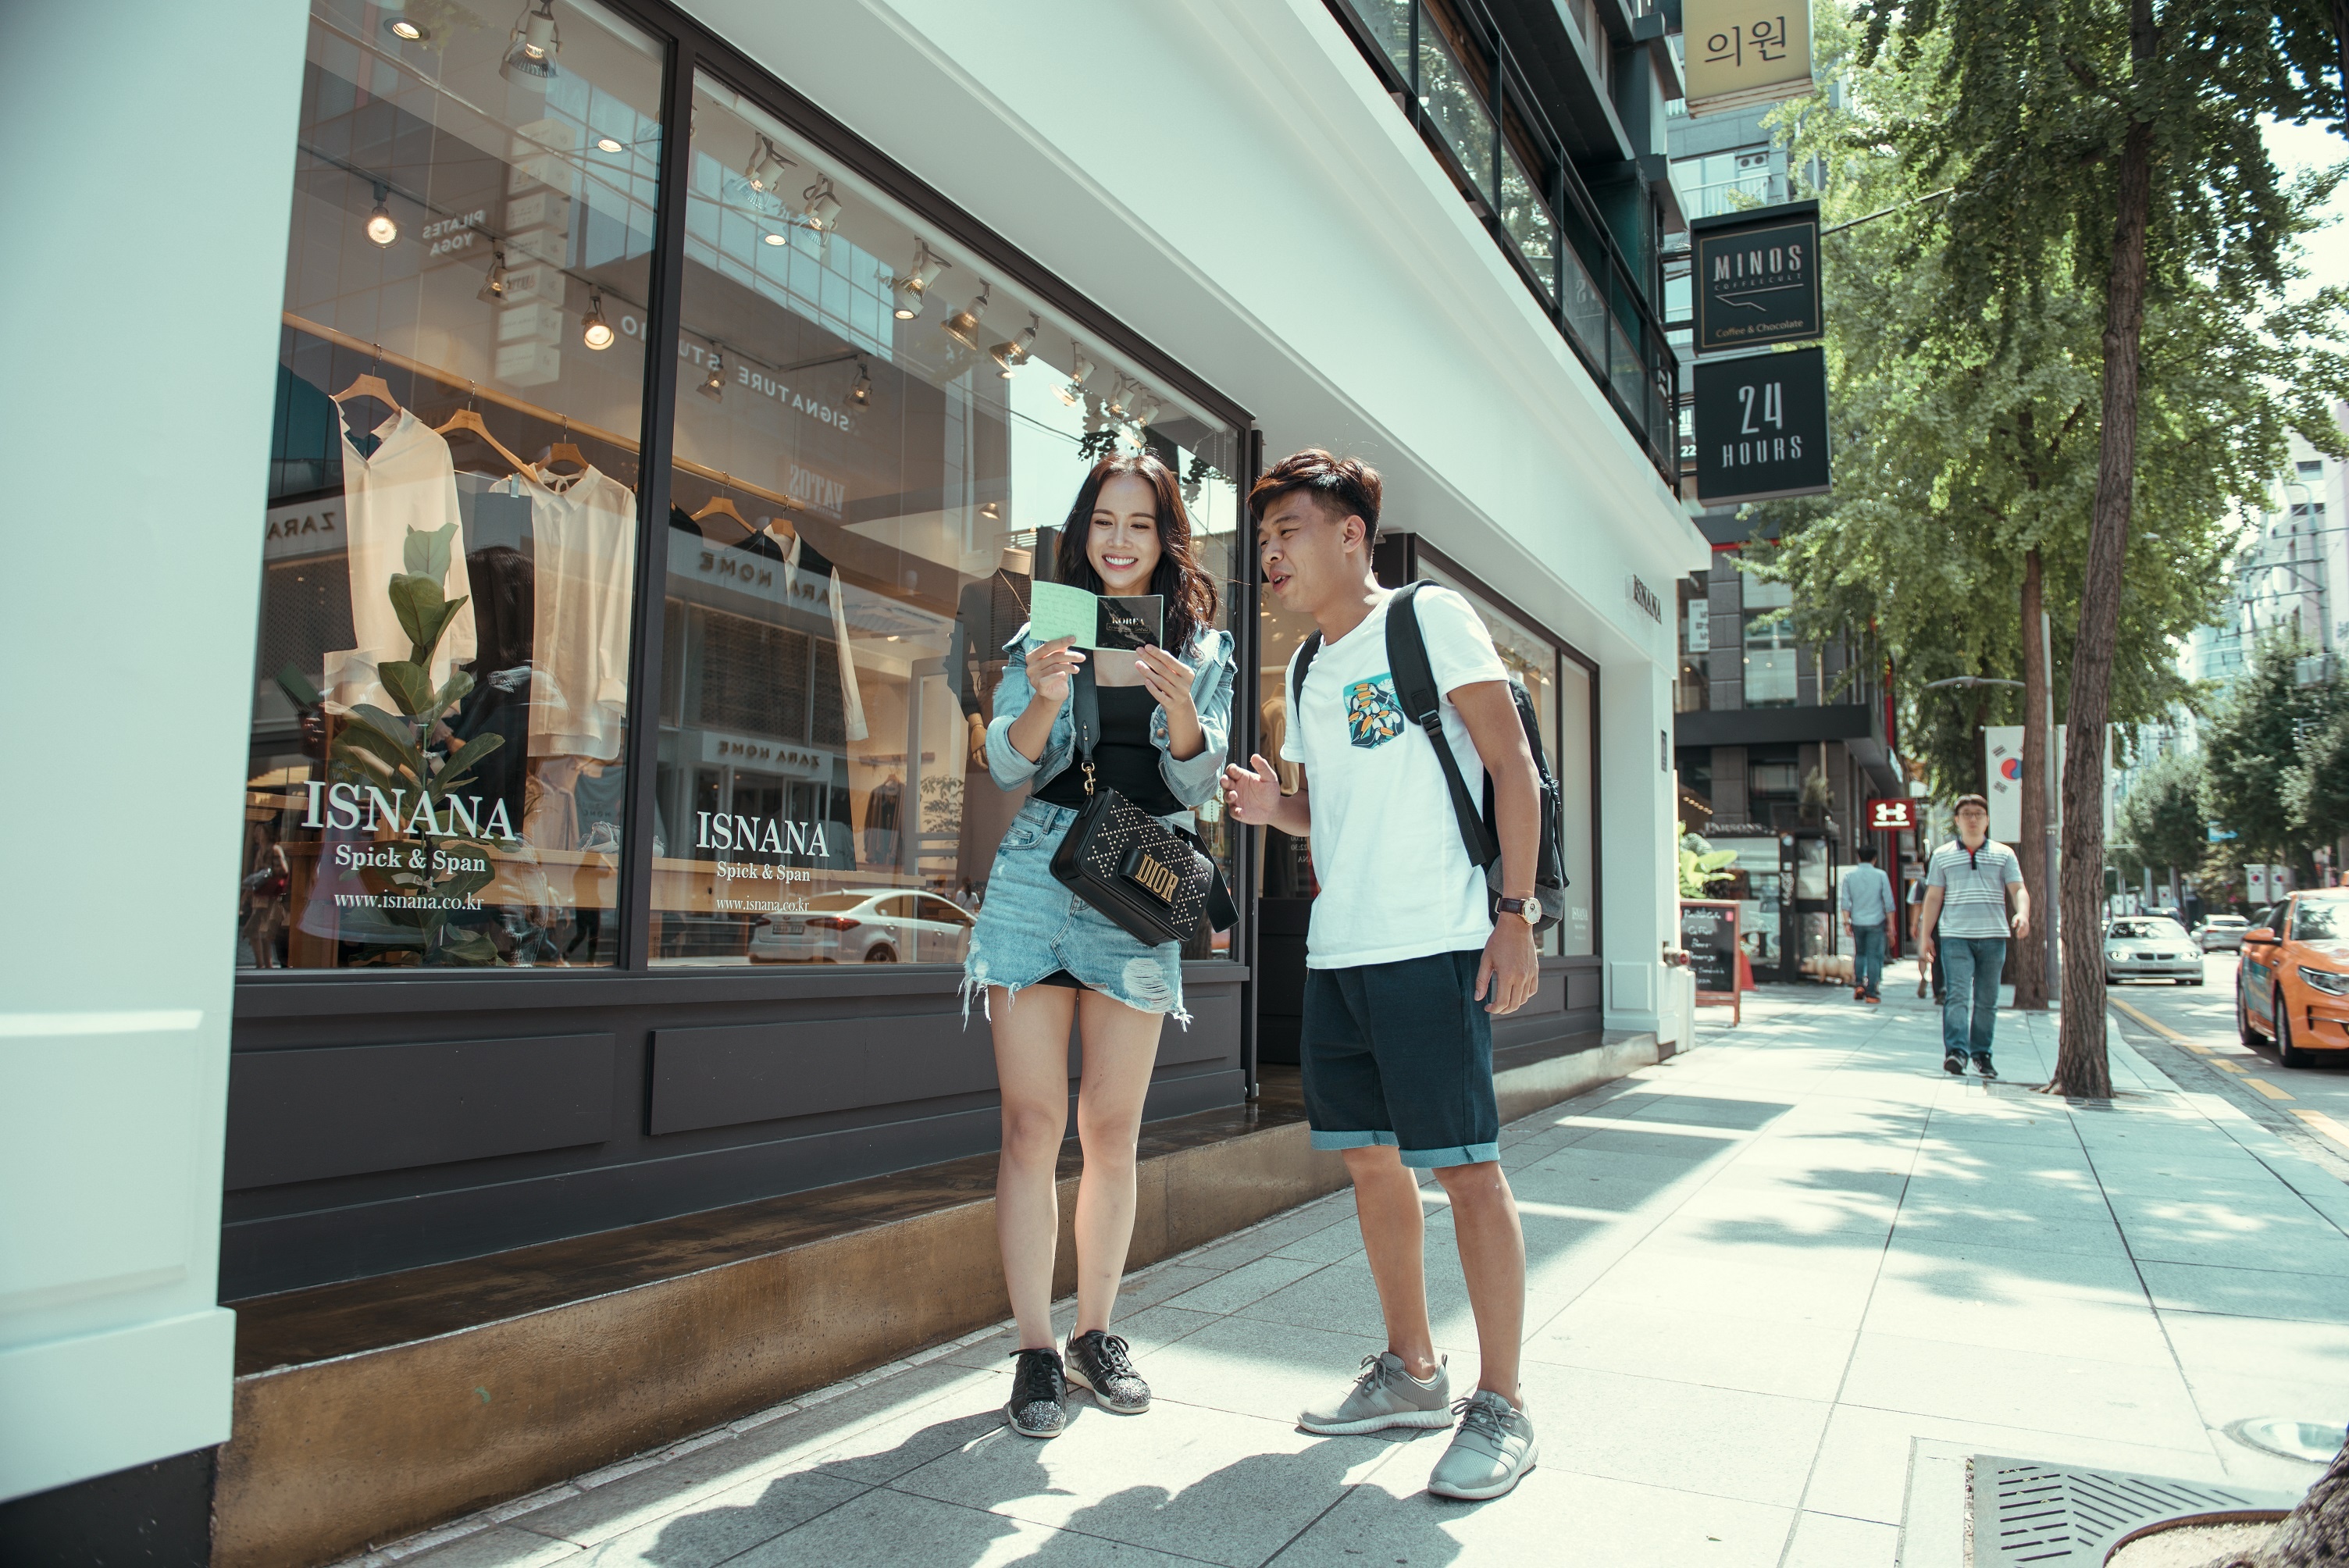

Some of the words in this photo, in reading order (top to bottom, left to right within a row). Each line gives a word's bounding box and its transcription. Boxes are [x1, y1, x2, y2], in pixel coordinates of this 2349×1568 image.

[1705, 16, 1787, 67] 의원
[1713, 244, 1802, 282] MINOS
[1716, 326, 1746, 338] Coffee
[1748, 324, 1755, 333] &
[1757, 319, 1804, 333] Chocolate
[1738, 382, 1783, 434] 24
[1722, 435, 1802, 468] HOURS
[299, 780, 517, 841] ISNANA
[696, 811, 830, 857] ISNANA
[335, 844, 401, 871] Spick
[408, 849, 426, 869] &
[432, 850, 487, 875] Span
[717, 861, 757, 882] Spick
[761, 864, 773, 879] &
[776, 864, 811, 884] Span
[1135, 853, 1178, 903] DIOR
[334, 889, 484, 911] www.isnana.co.kr
[716, 895, 810, 912] www.isnana.co.kr
